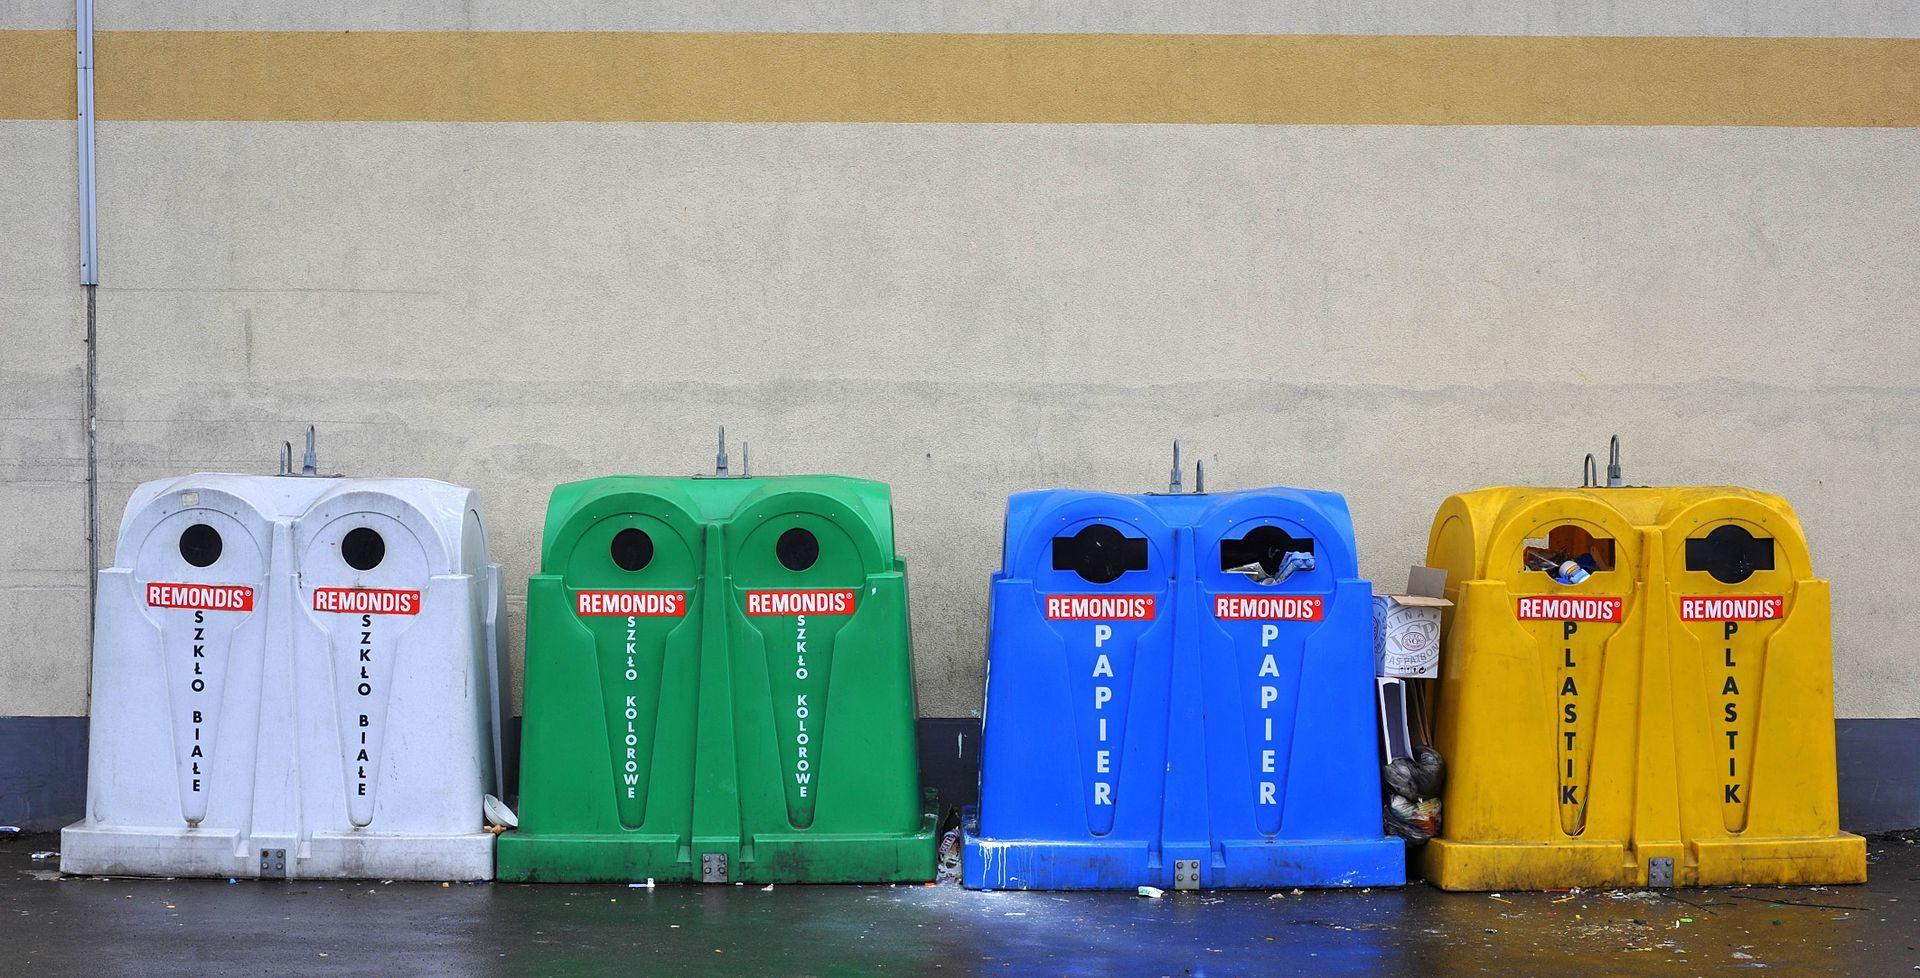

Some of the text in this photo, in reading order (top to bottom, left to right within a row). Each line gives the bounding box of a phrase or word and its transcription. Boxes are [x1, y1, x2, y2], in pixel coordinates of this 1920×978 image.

[192, 611, 204, 791] SZKŁO BIAŁE
[357, 615, 371, 795] SZKŁO BIAŁE
[624, 616, 638, 798] SZKŁO KOLOROWE
[796, 615, 810, 797] SZKŁO KOLOROWE
[1093, 625, 1113, 804] PAPIER
[1259, 625, 1279, 804] PAPIER
[1561, 622, 1578, 804] PLASTIK
[1722, 622, 1740, 803] PLASTIK
